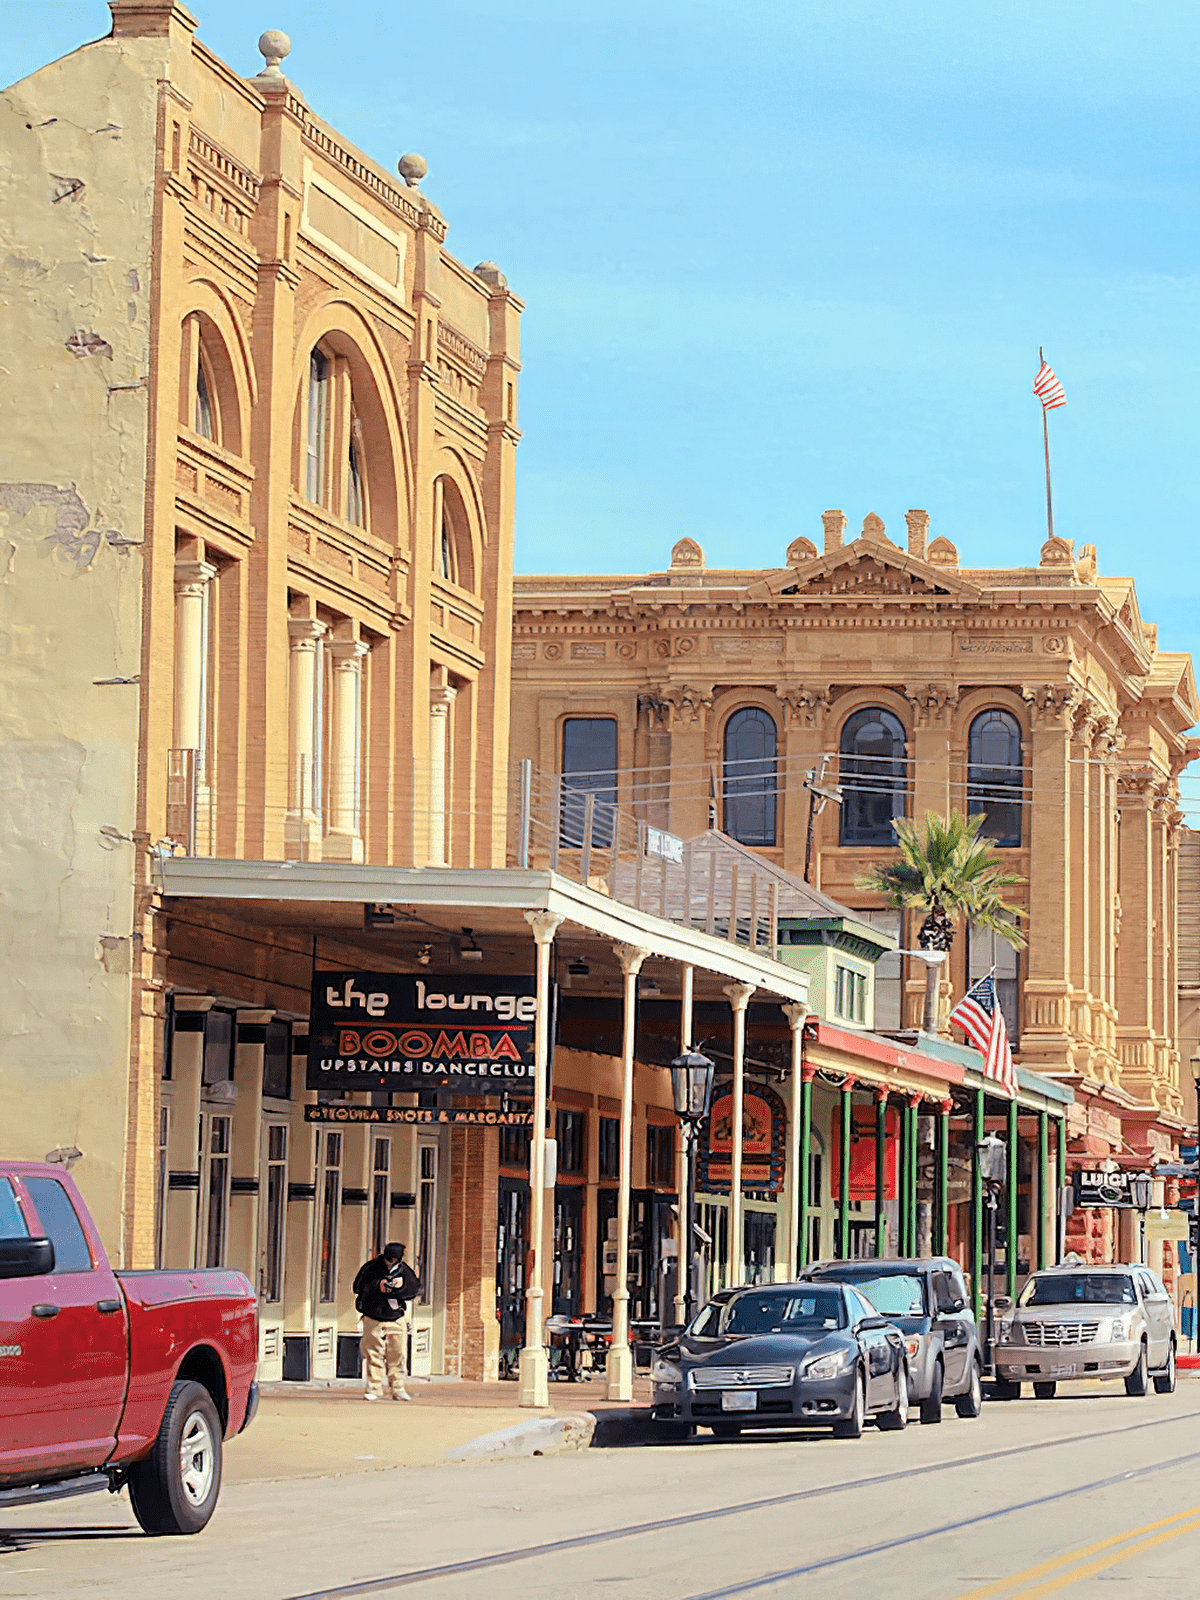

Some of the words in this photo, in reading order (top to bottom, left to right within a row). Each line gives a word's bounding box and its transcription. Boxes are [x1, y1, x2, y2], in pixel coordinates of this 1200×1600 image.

[326, 978, 389, 1017] the
[416, 980, 537, 1021] lounge
[339, 1030, 522, 1061] BOOMBA
[320, 1059, 413, 1073] UPSTAIRS
